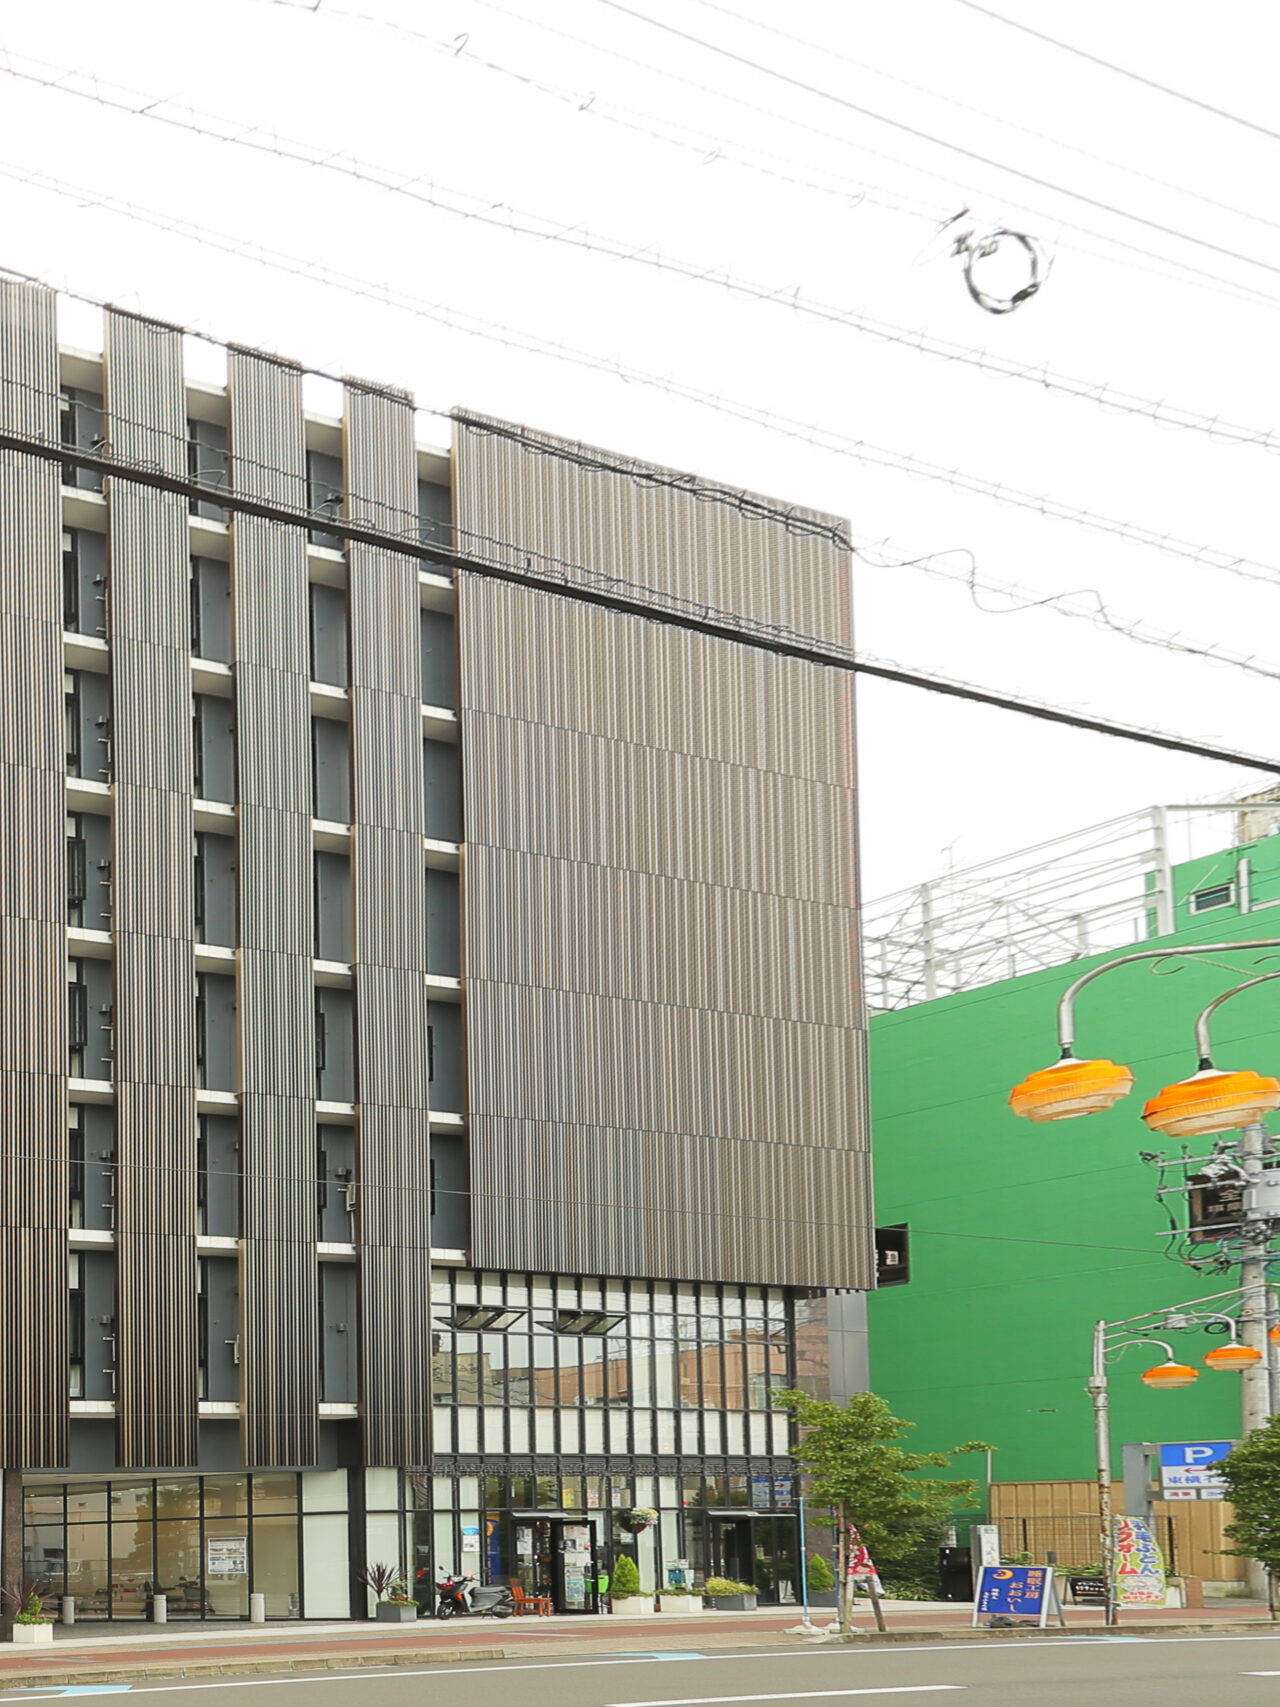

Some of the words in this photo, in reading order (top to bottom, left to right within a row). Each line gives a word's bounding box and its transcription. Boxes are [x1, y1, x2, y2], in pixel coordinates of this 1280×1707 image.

[1184, 1446, 1214, 1464] P
[1006, 1581, 1024, 1613] おおいし
